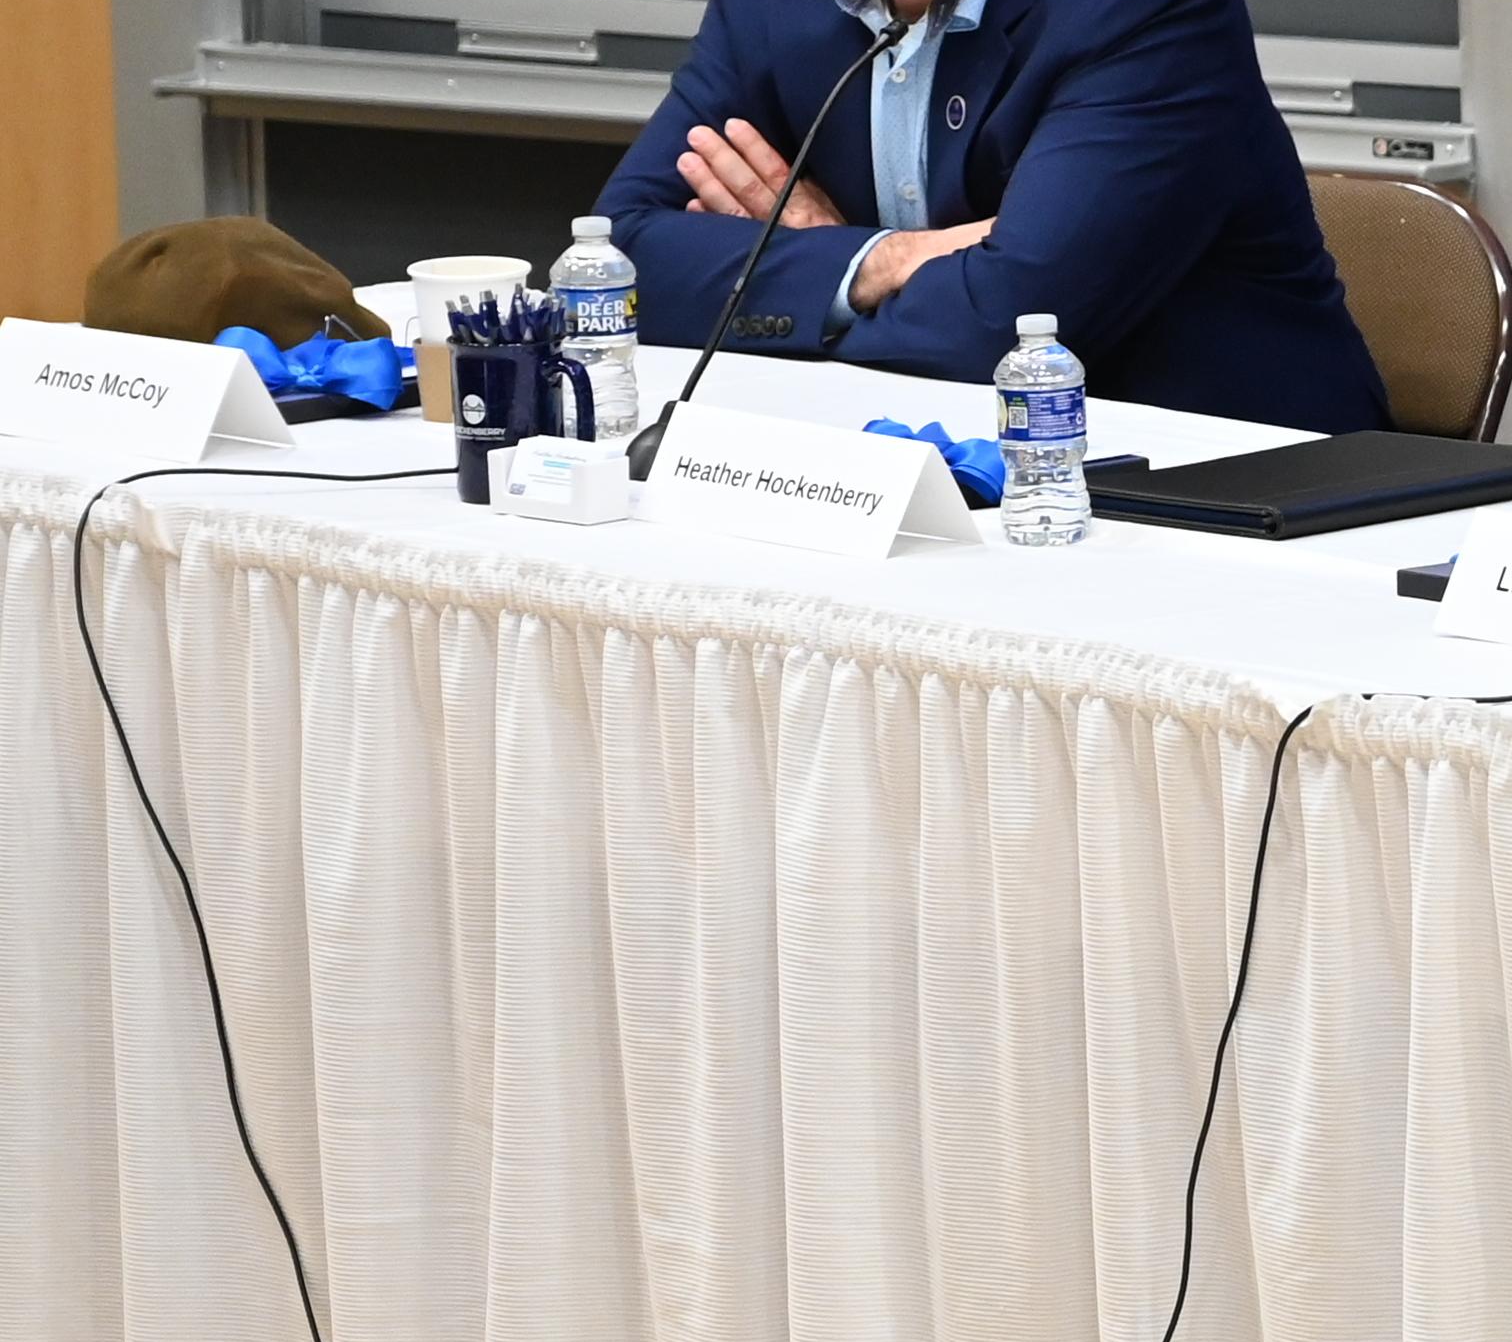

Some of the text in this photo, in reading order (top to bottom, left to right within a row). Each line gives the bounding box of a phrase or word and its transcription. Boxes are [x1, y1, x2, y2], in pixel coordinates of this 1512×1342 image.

[577, 300, 624, 316] DEER
[577, 315, 627, 333] PARK
[35, 363, 168, 409] Amos McCoy
[674, 456, 884, 516] Heather Hockenberry
